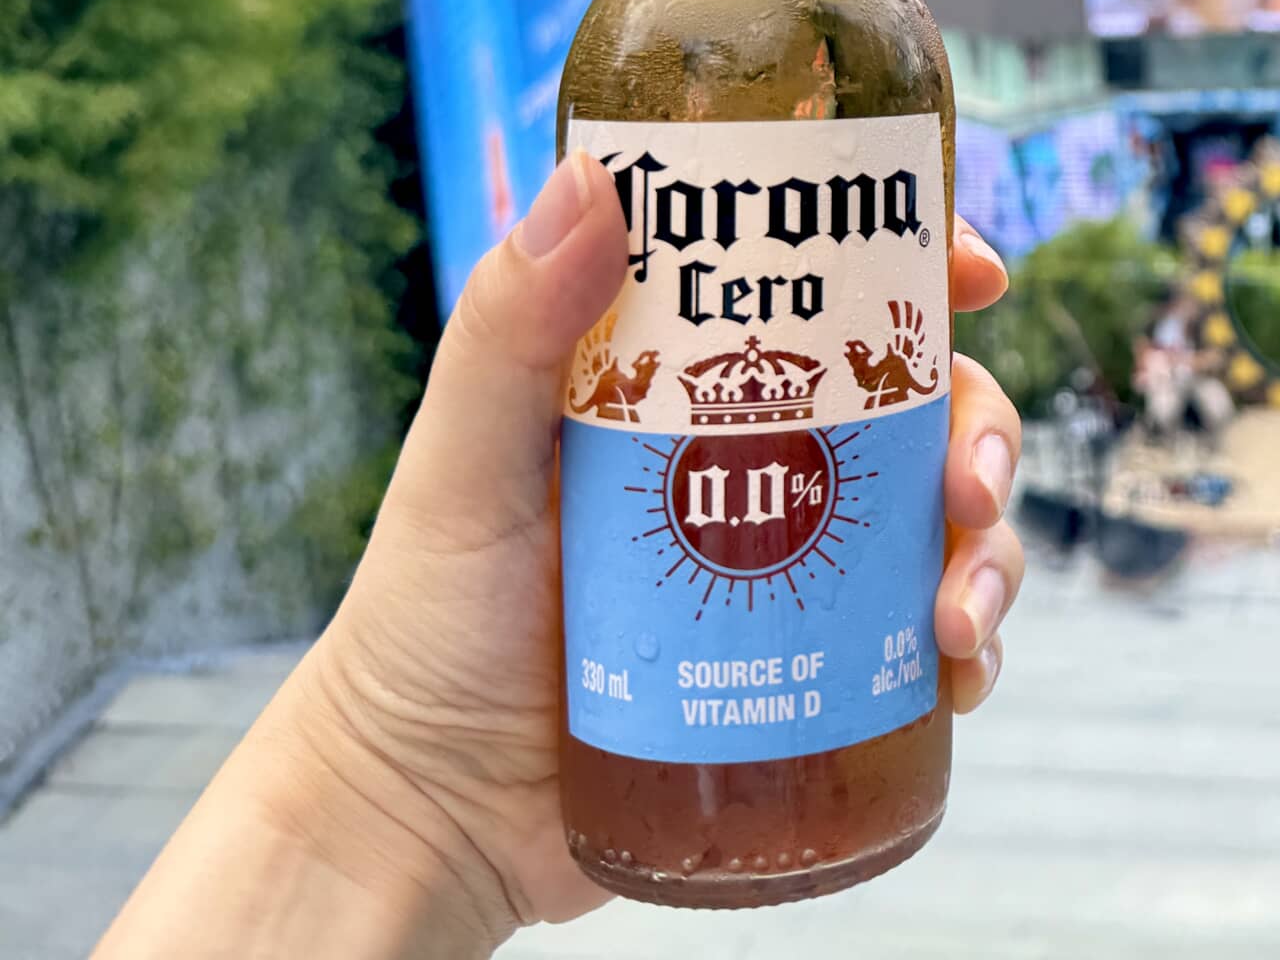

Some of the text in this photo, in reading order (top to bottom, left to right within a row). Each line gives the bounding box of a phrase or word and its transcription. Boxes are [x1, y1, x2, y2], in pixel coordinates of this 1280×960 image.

[678, 260, 824, 327] Cero
[684, 461, 823, 527] 0.0%
[884, 625, 917, 662] 0.0%
[581, 658, 632, 702] 330 mL
[677, 651, 825, 689] SOURCE OF
[872, 650, 923, 696] alc./vol.
[681, 689, 821, 726] VITAMIN D
